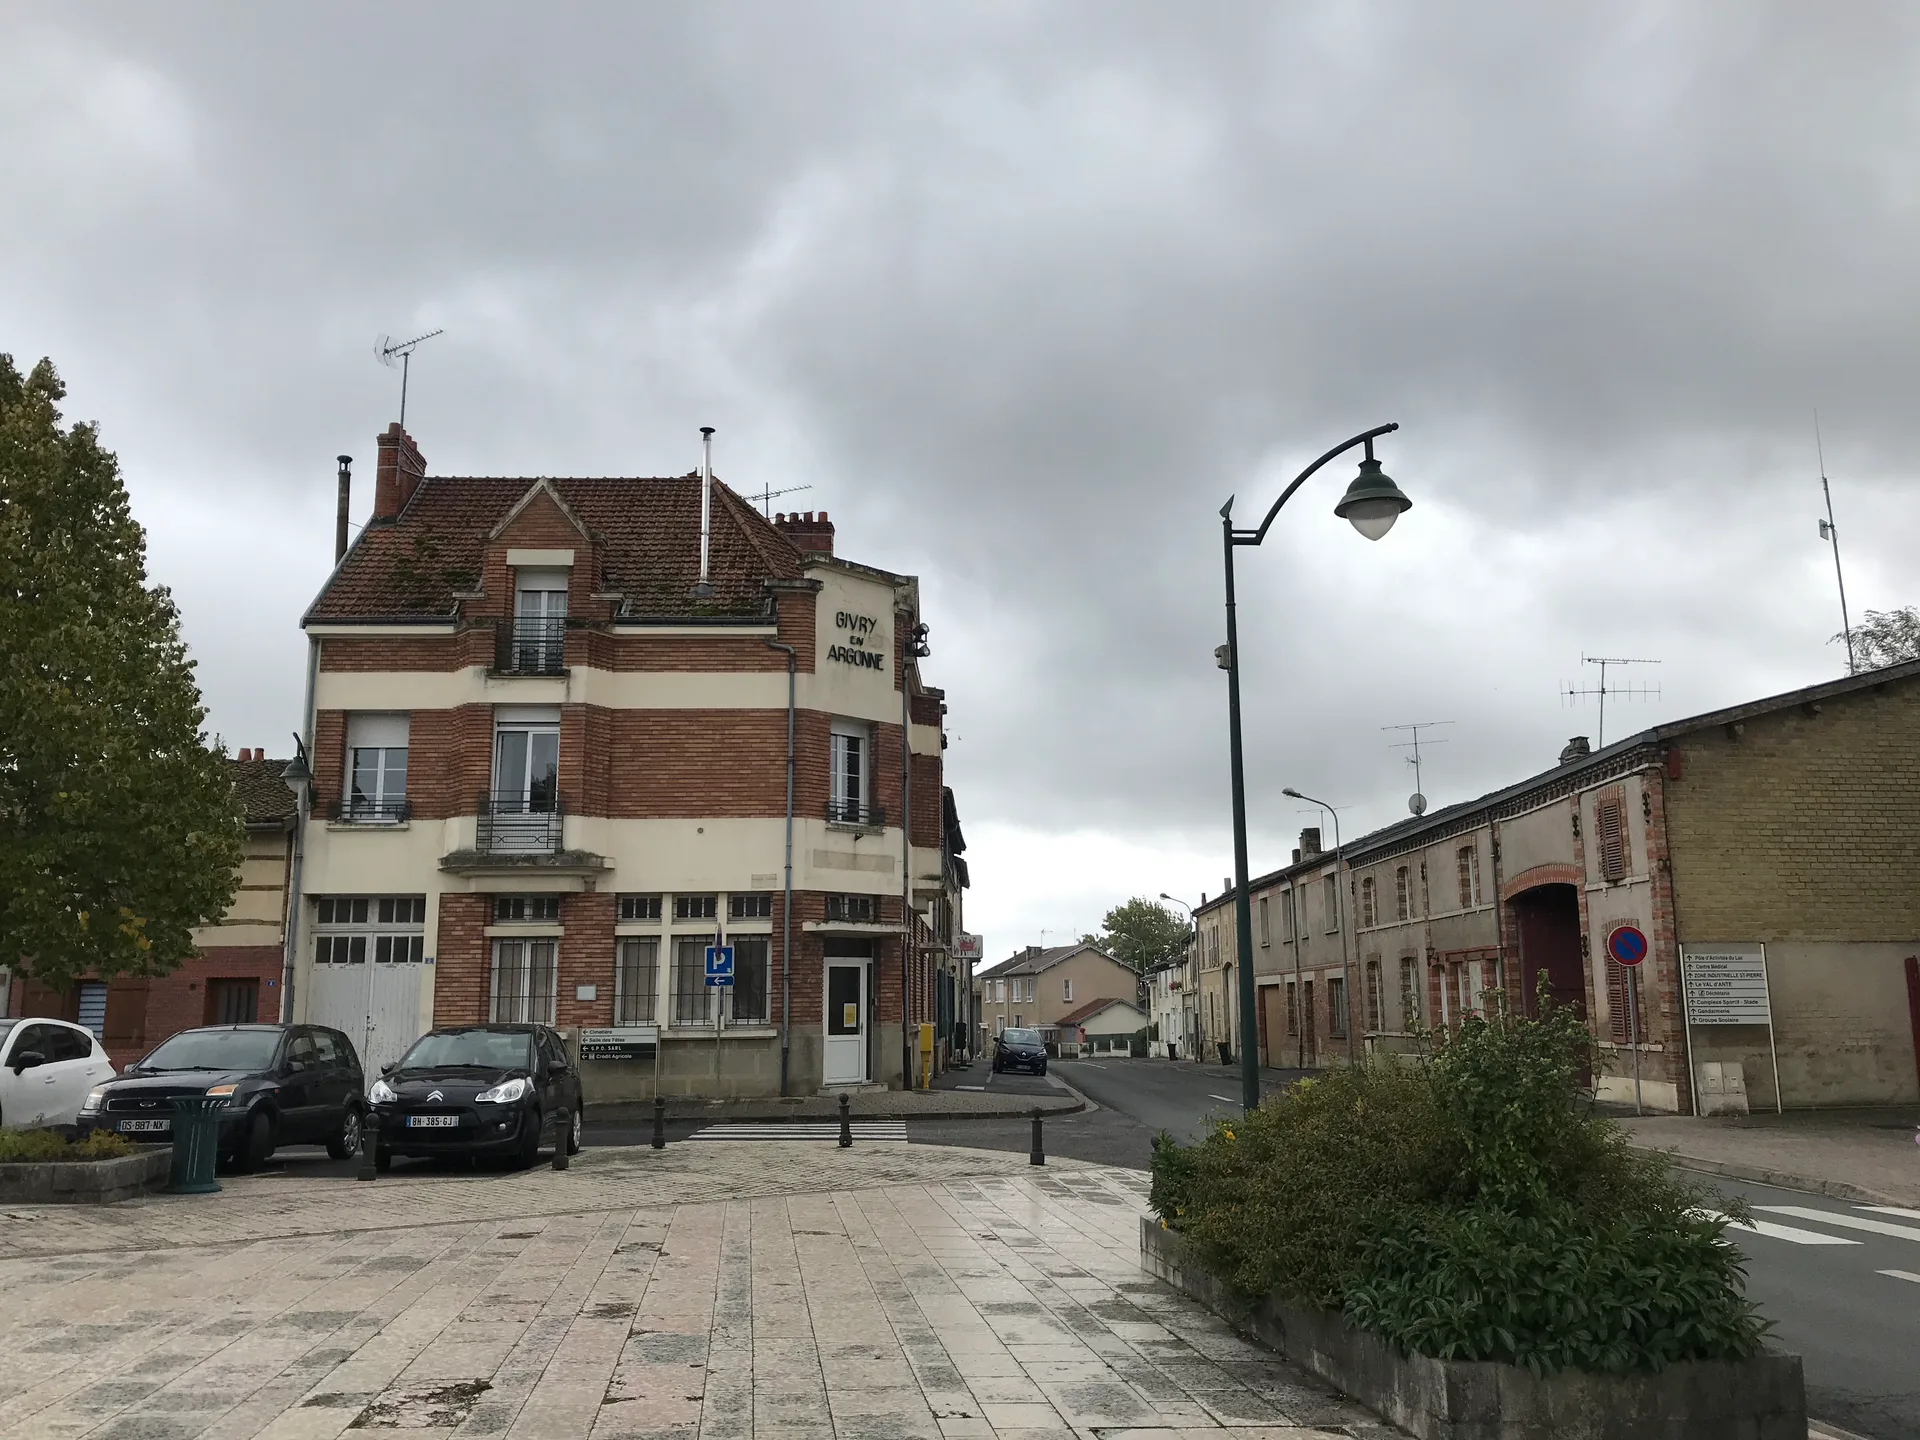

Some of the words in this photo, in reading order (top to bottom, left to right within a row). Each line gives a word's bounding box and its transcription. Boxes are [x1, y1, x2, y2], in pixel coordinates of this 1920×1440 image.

[836, 611, 877, 634] GIVRY
[850, 635, 864, 647] EN
[827, 644, 885, 671] ARGONNE
[713, 951, 726, 970] P
